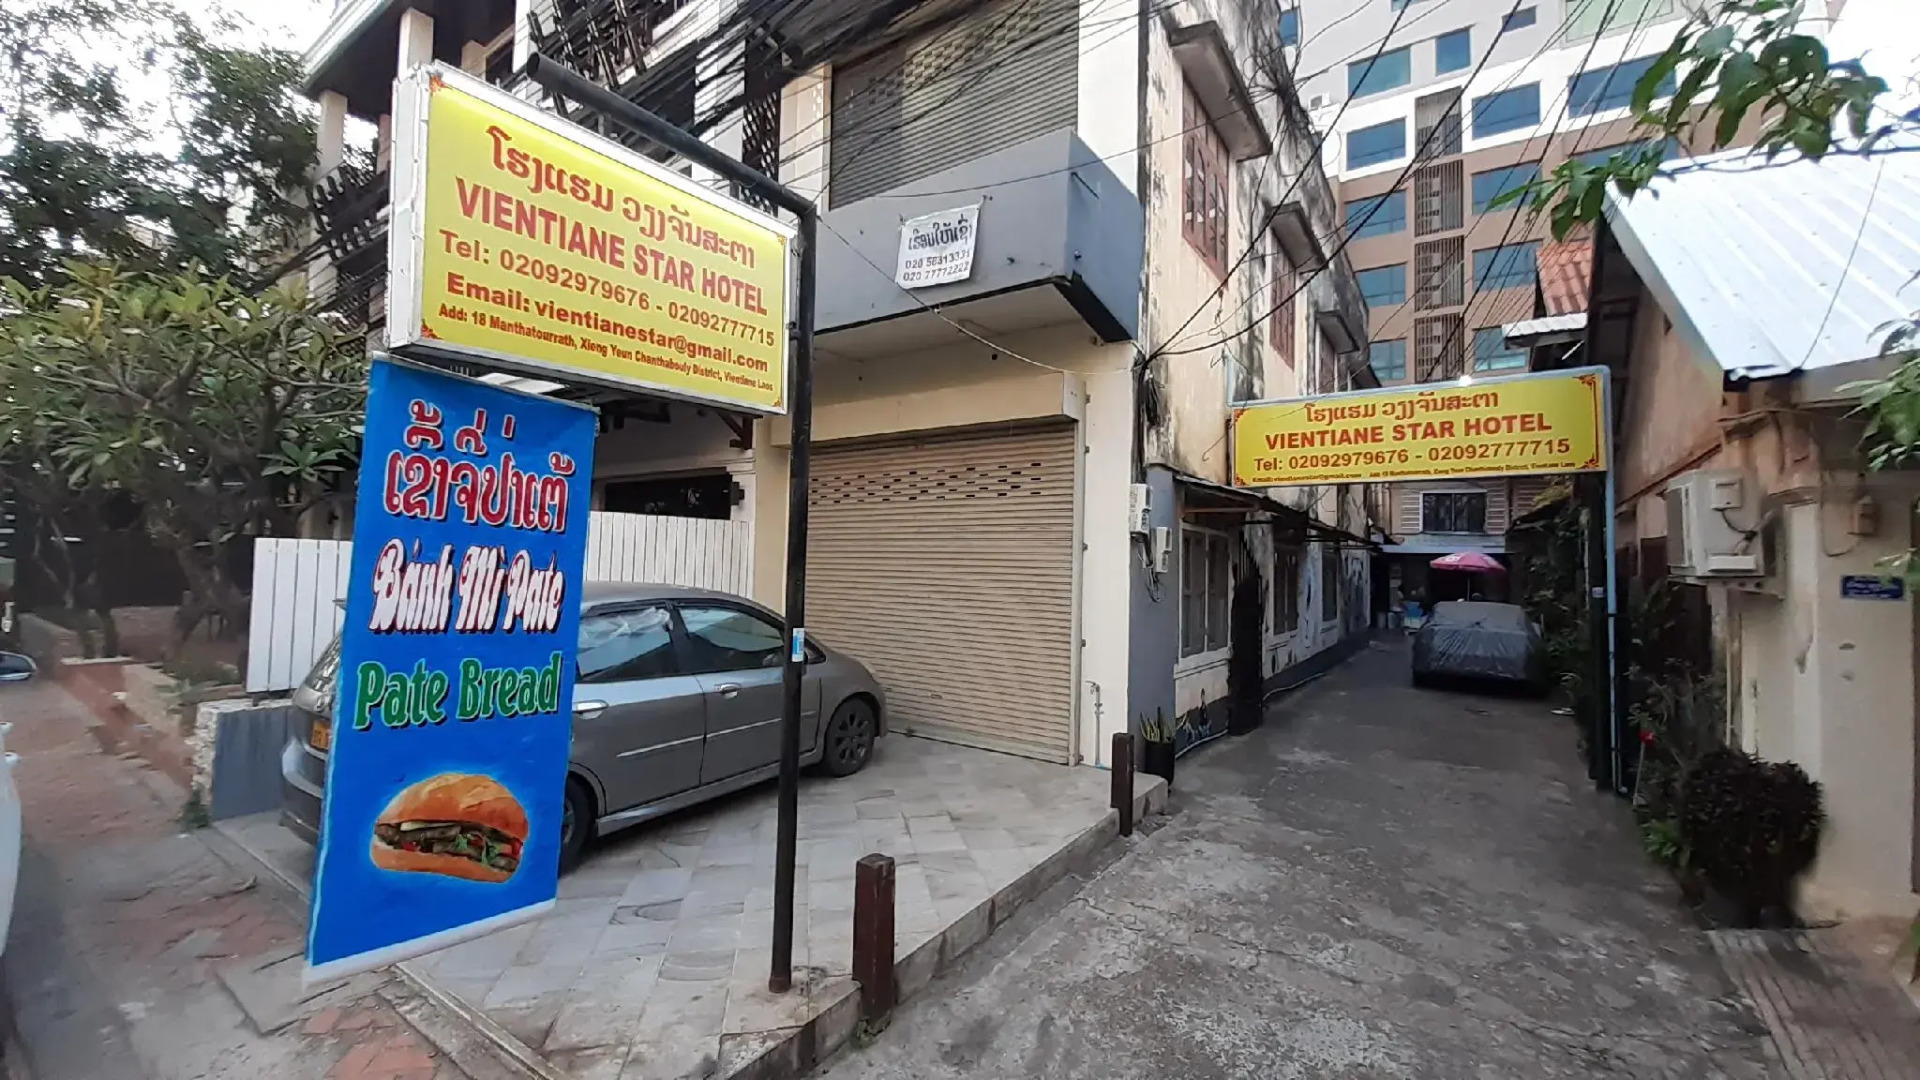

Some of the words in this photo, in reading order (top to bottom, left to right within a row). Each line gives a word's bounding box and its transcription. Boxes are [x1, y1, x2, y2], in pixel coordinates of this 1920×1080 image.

[455, 175, 625, 269] VIENTIANE
[633, 244, 695, 293] STAR
[701, 267, 768, 316] HOTEL
[903, 271, 921, 281] 020
[905, 258, 923, 269] 020
[439, 229, 490, 265] Tel:
[500, 249, 650, 311] 02092979676
[668, 301, 775, 346] 02092777715
[438, 303, 468, 322] Add:
[472, 312, 487, 326] 18
[1265, 425, 1384, 451] VIENTIANE
[1392, 420, 1456, 442] STAR
[1464, 413, 1552, 437] HOTEL
[1254, 457, 1283, 471] Tel:
[1289, 449, 1409, 469] 02092979676
[1428, 438, 1570, 462] 02092777715
[353, 658, 449, 730] Pate
[456, 651, 563, 720] Bread
